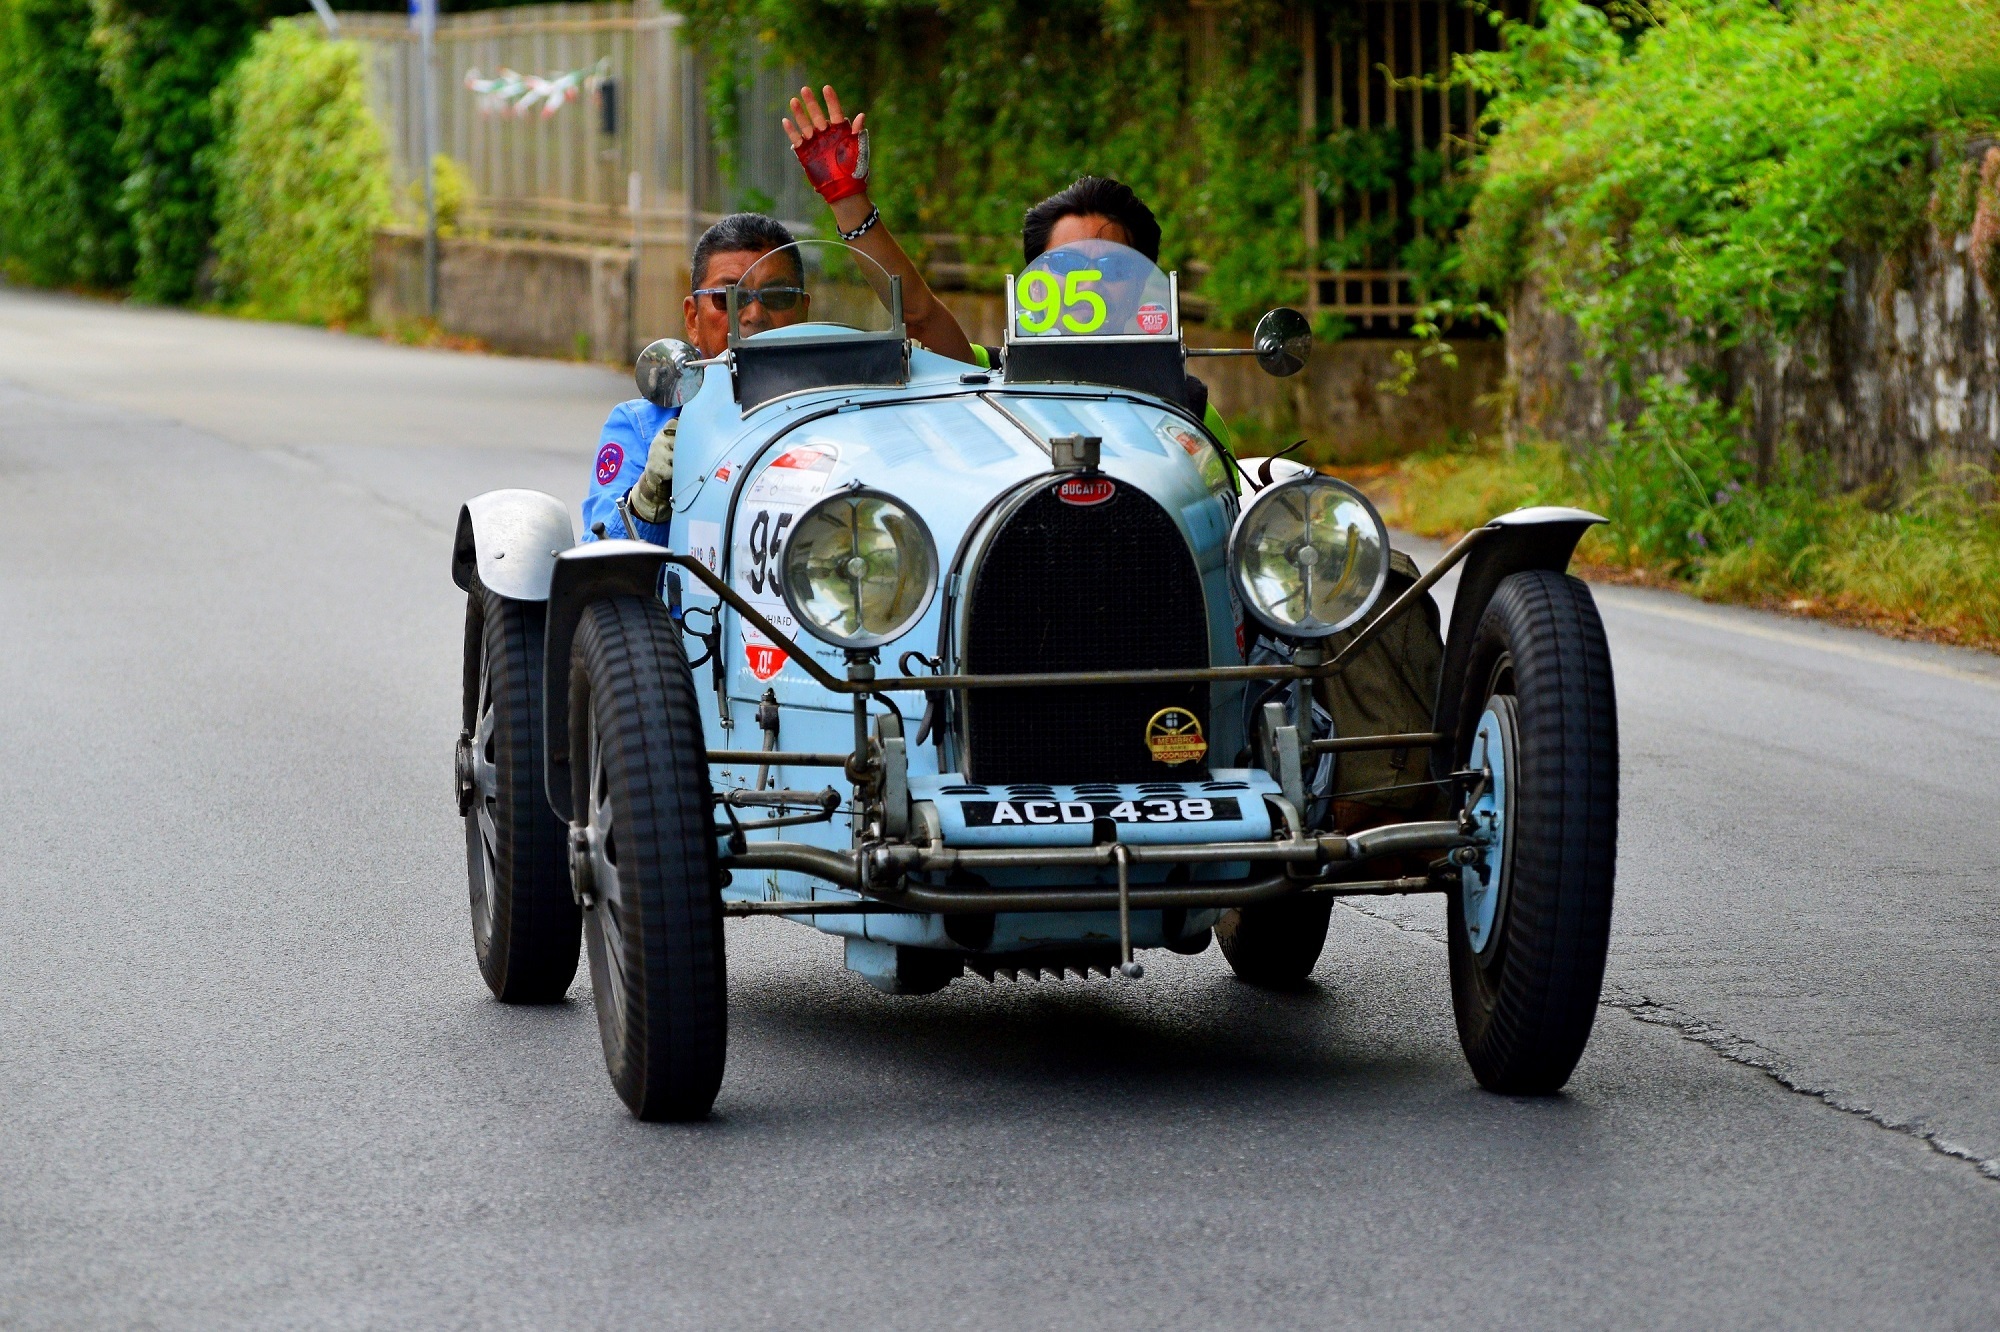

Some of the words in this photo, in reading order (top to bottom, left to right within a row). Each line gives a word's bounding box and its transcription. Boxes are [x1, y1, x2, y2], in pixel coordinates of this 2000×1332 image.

[1017, 270, 1107, 333] 95
[1142, 314, 1164, 325] 2015
[1061, 483, 1107, 495] BUGATTI
[750, 510, 793, 597] 95
[1157, 736, 1196, 745] MEMBRO
[991, 801, 1095, 824] ACD
[1109, 798, 1215, 822] 438
